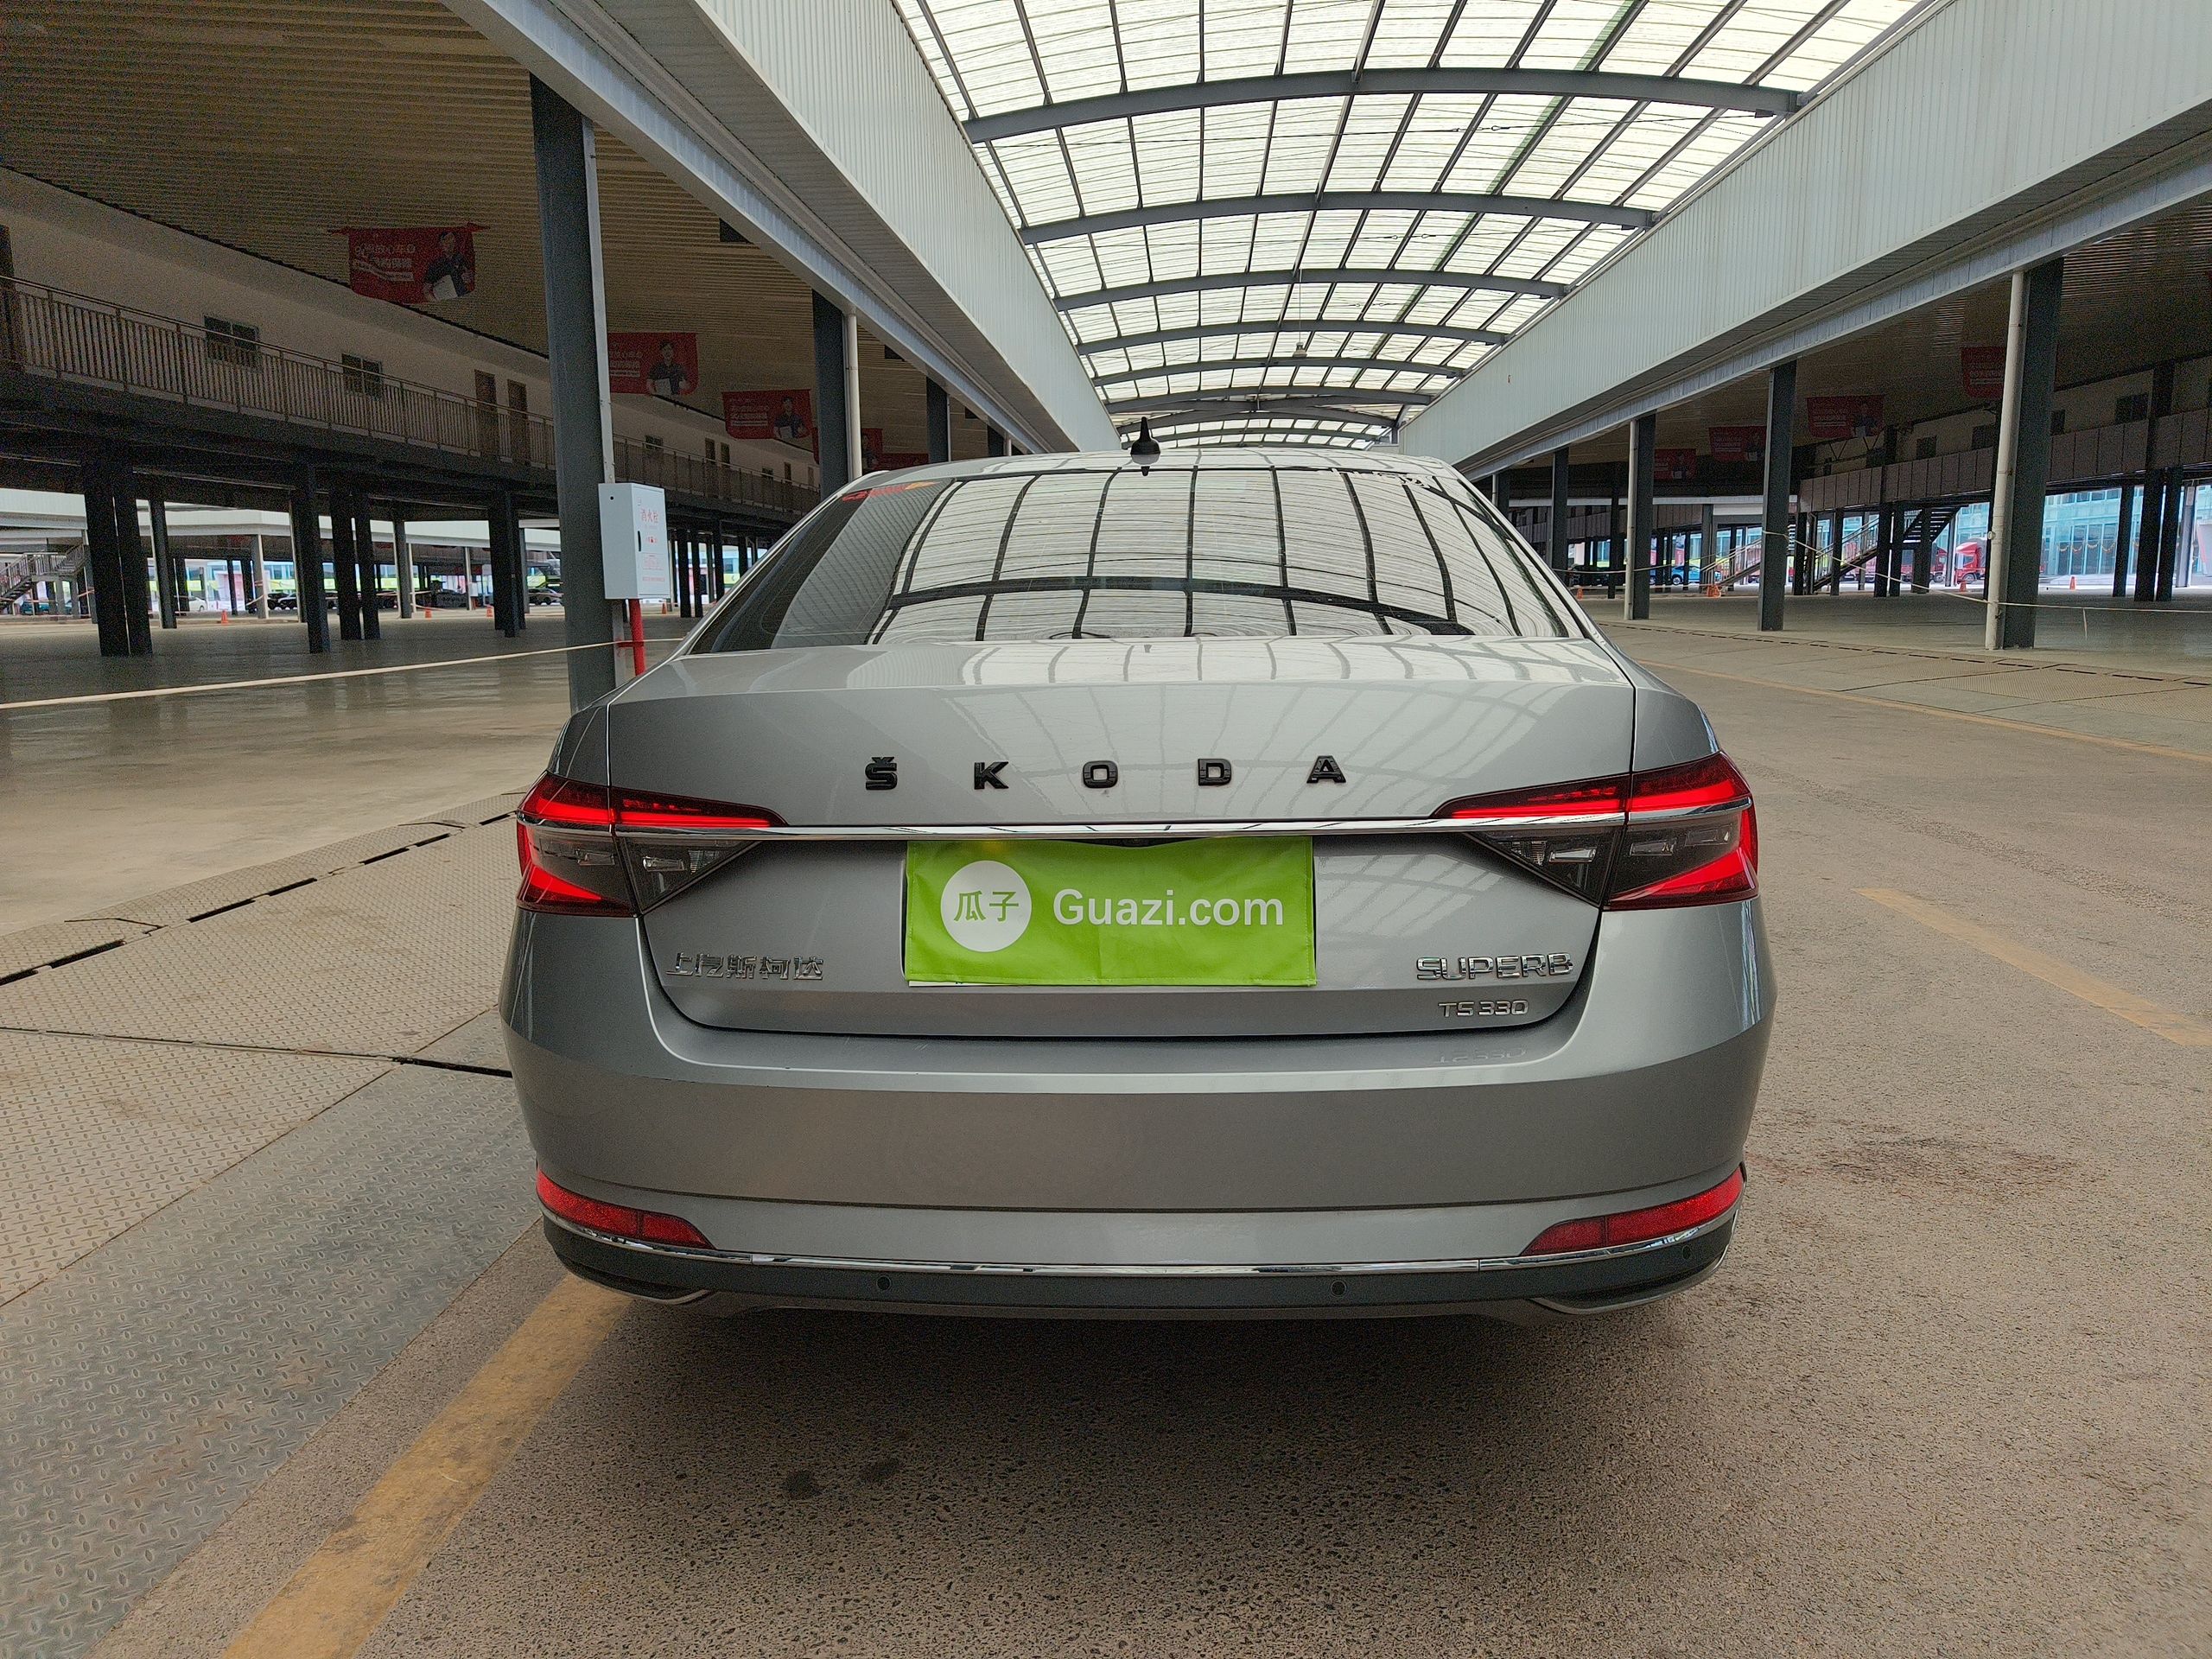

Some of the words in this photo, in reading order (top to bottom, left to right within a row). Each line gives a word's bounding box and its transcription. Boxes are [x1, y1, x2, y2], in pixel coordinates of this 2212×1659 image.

[953, 890, 1020, 923] 瓜子
[1052, 888, 1284, 926] Guazi.com
[665, 951, 823, 980] 上汽斯柯达
[1416, 952, 1573, 980] SUPERB
[1438, 1001, 1475, 1018] TS
[1478, 1000, 1529, 1016] 330
